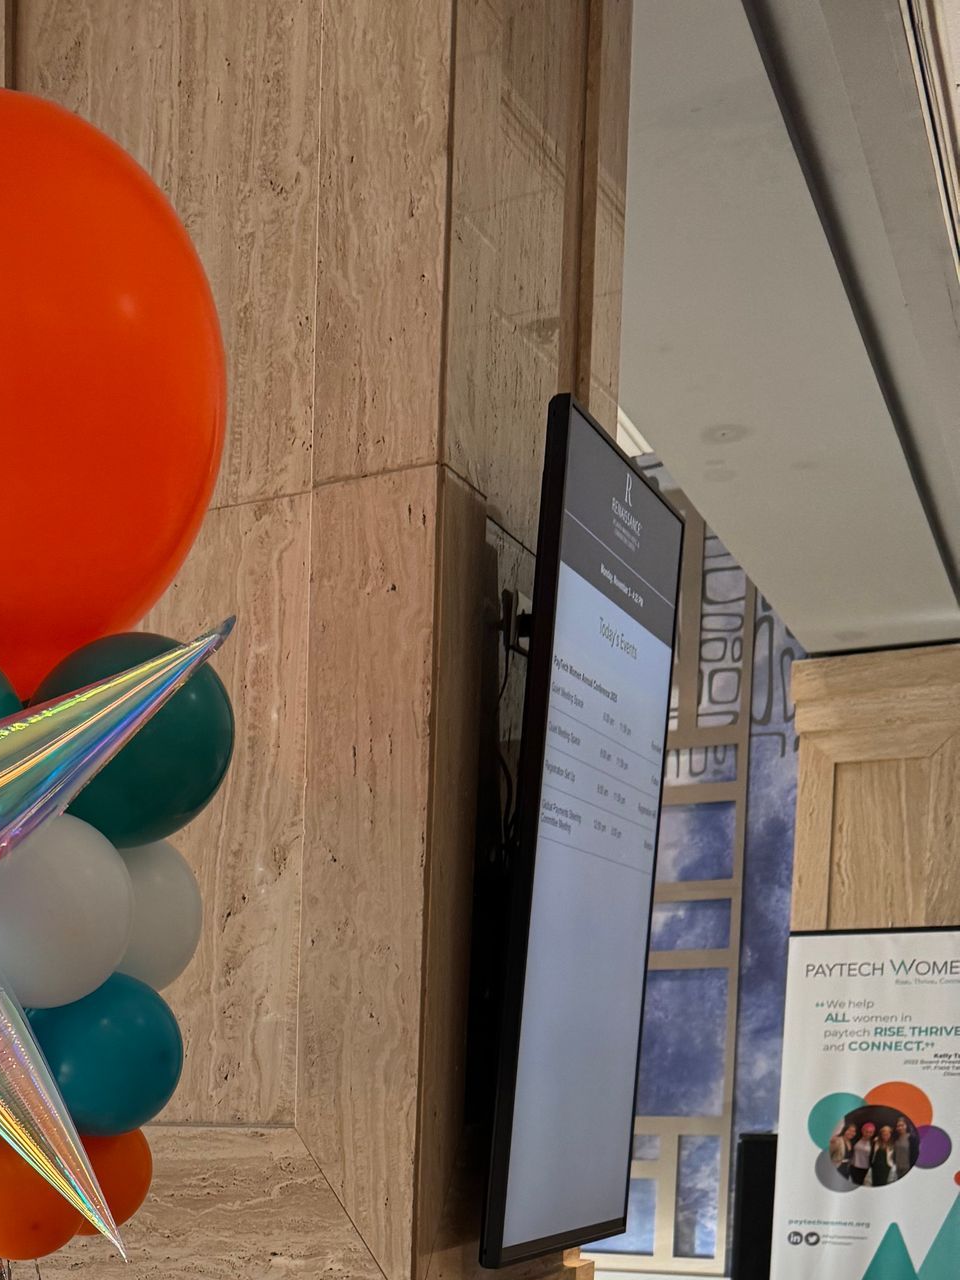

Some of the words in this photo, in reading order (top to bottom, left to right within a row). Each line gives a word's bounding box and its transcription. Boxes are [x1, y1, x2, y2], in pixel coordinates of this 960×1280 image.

[624, 472, 633, 508] R
[611, 496, 642, 537] RENAISSANCE
[599, 616, 620, 648] Today's
[620, 632, 638, 660] Events
[805, 963, 884, 977] PAYTECH
[890, 959, 960, 975] WOME
[848, 1000, 875, 1010] help
[824, 1013, 850, 1023] ALL
[852, 1015, 898, 1023] women
[901, 1012, 913, 1023] in
[824, 1027, 871, 1040] paytech
[823, 1042, 846, 1052] and
